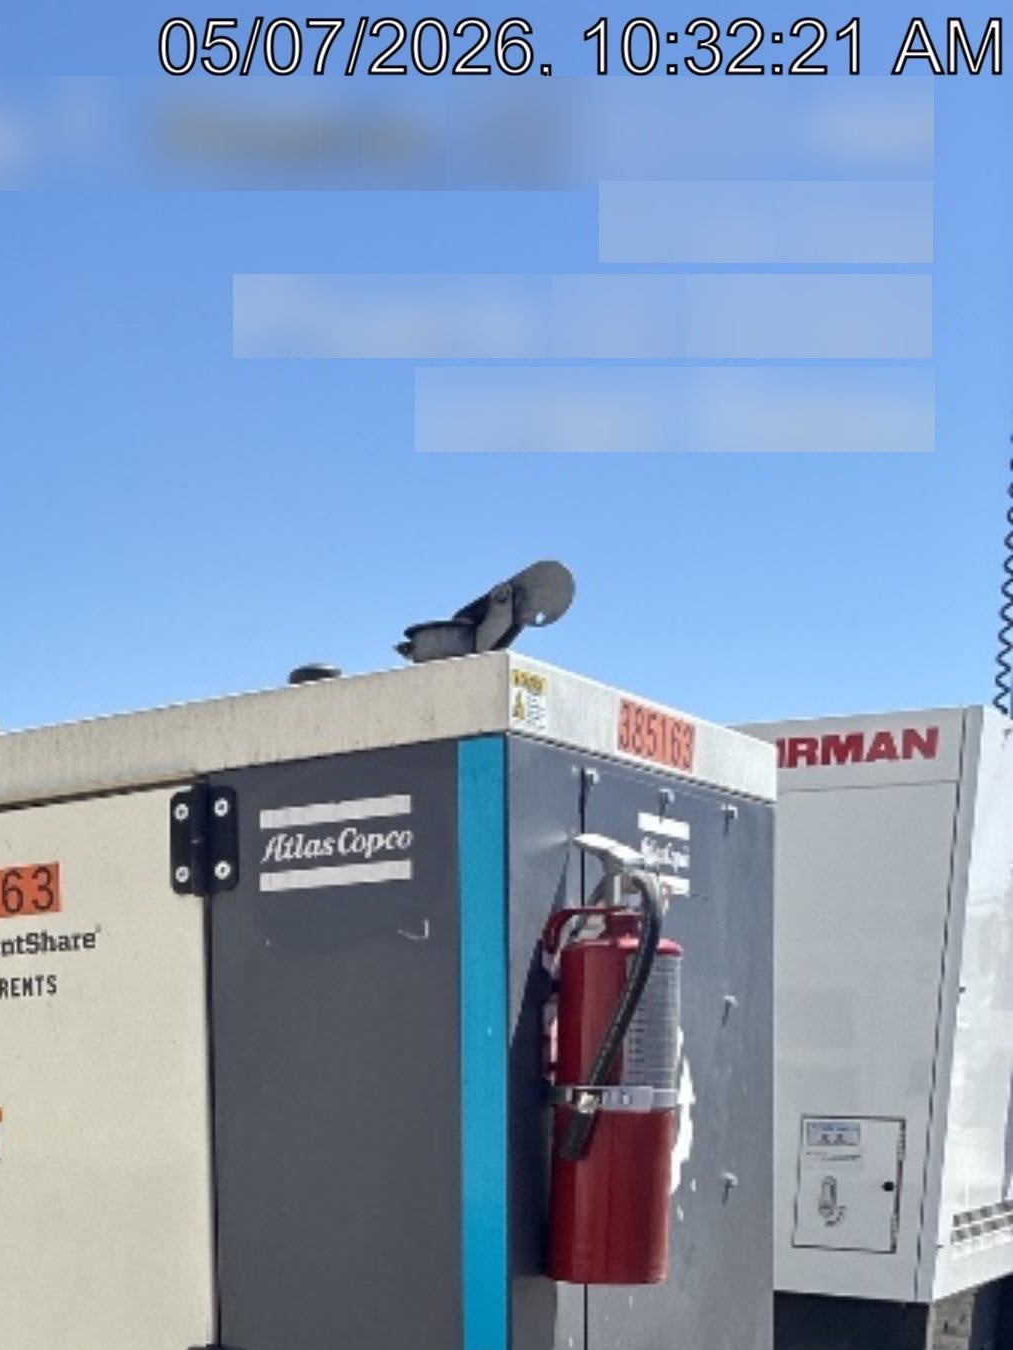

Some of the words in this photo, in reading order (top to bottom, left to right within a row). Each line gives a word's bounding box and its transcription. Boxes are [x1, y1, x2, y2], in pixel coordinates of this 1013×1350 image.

[619, 701, 694, 770] 385163
[776, 725, 940, 768] IRMAN
[260, 833, 336, 864] Atlas
[338, 827, 414, 859] Copco
